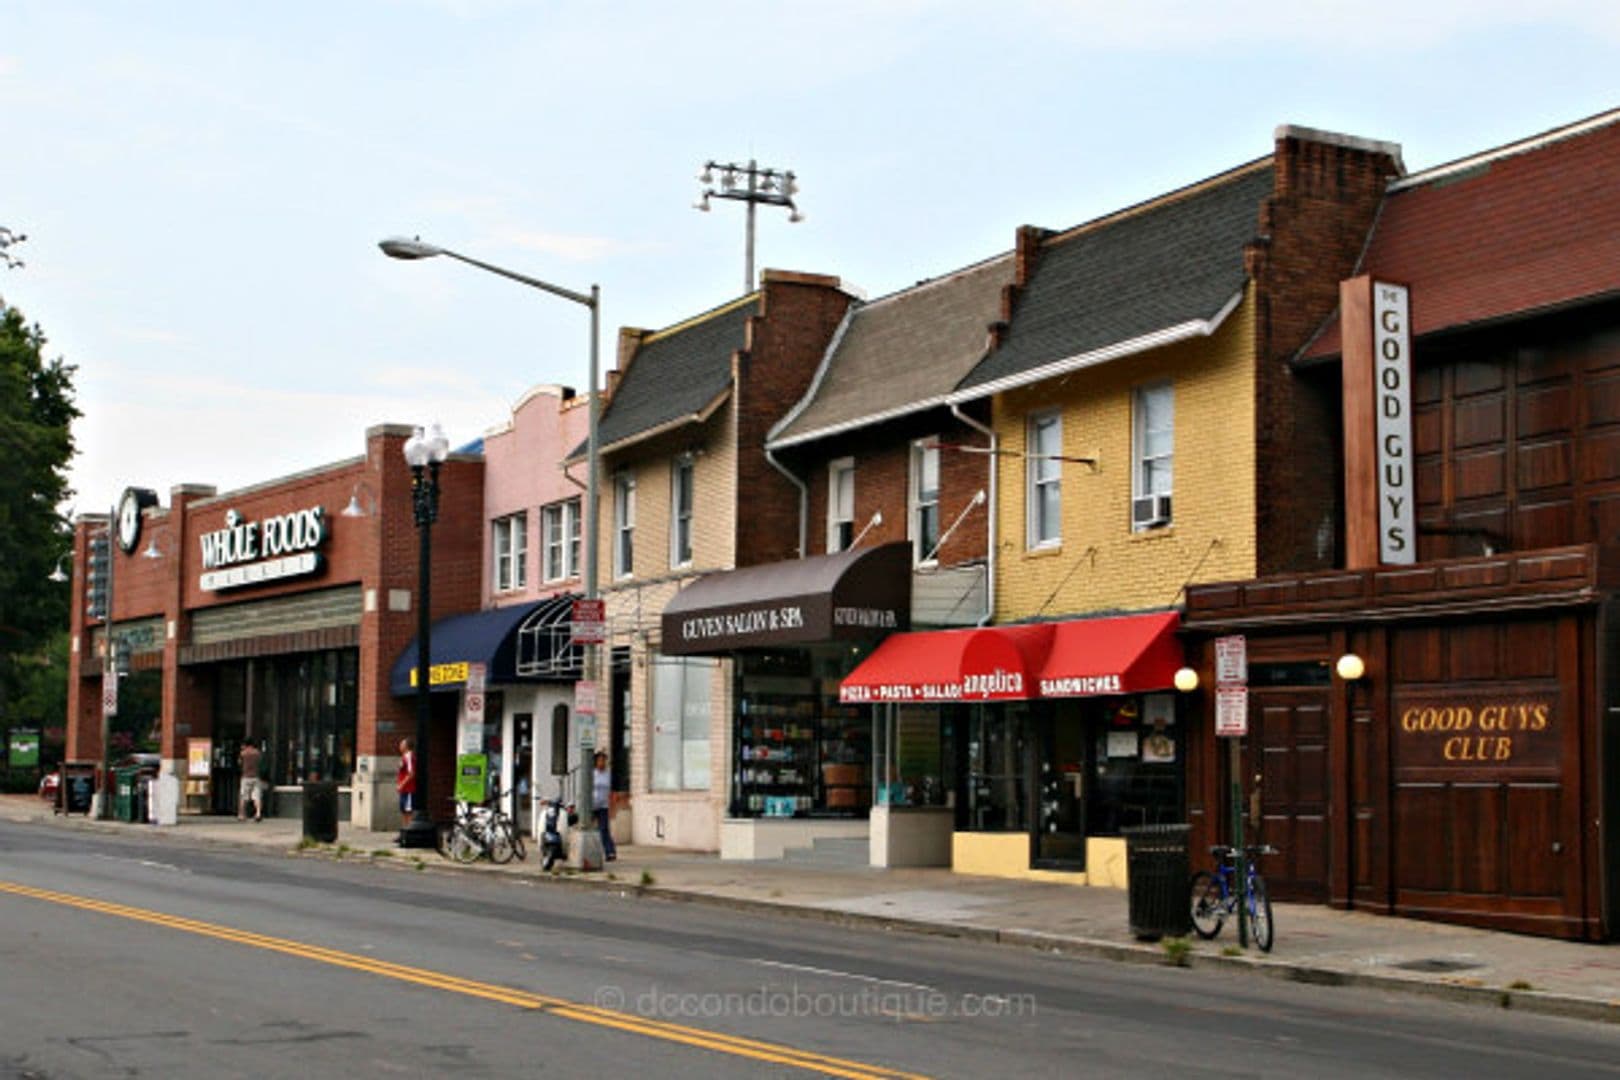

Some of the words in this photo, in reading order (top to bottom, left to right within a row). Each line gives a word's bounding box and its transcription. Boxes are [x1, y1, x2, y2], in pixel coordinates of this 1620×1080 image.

[1382, 310, 1401, 419] GOOD
[1384, 434, 1405, 551] GUYS
[199, 521, 257, 569] WHOLE
[261, 504, 320, 557] FOODS
[682, 615, 725, 639] GUVEN
[725, 610, 768, 635] SALON
[780, 606, 803, 629] SPA
[880, 685, 912, 699] PASTA
[1402, 706, 1473, 732] GOOD
[1479, 702, 1549, 731] GUYS
[1443, 735, 1513, 761] CLUB
